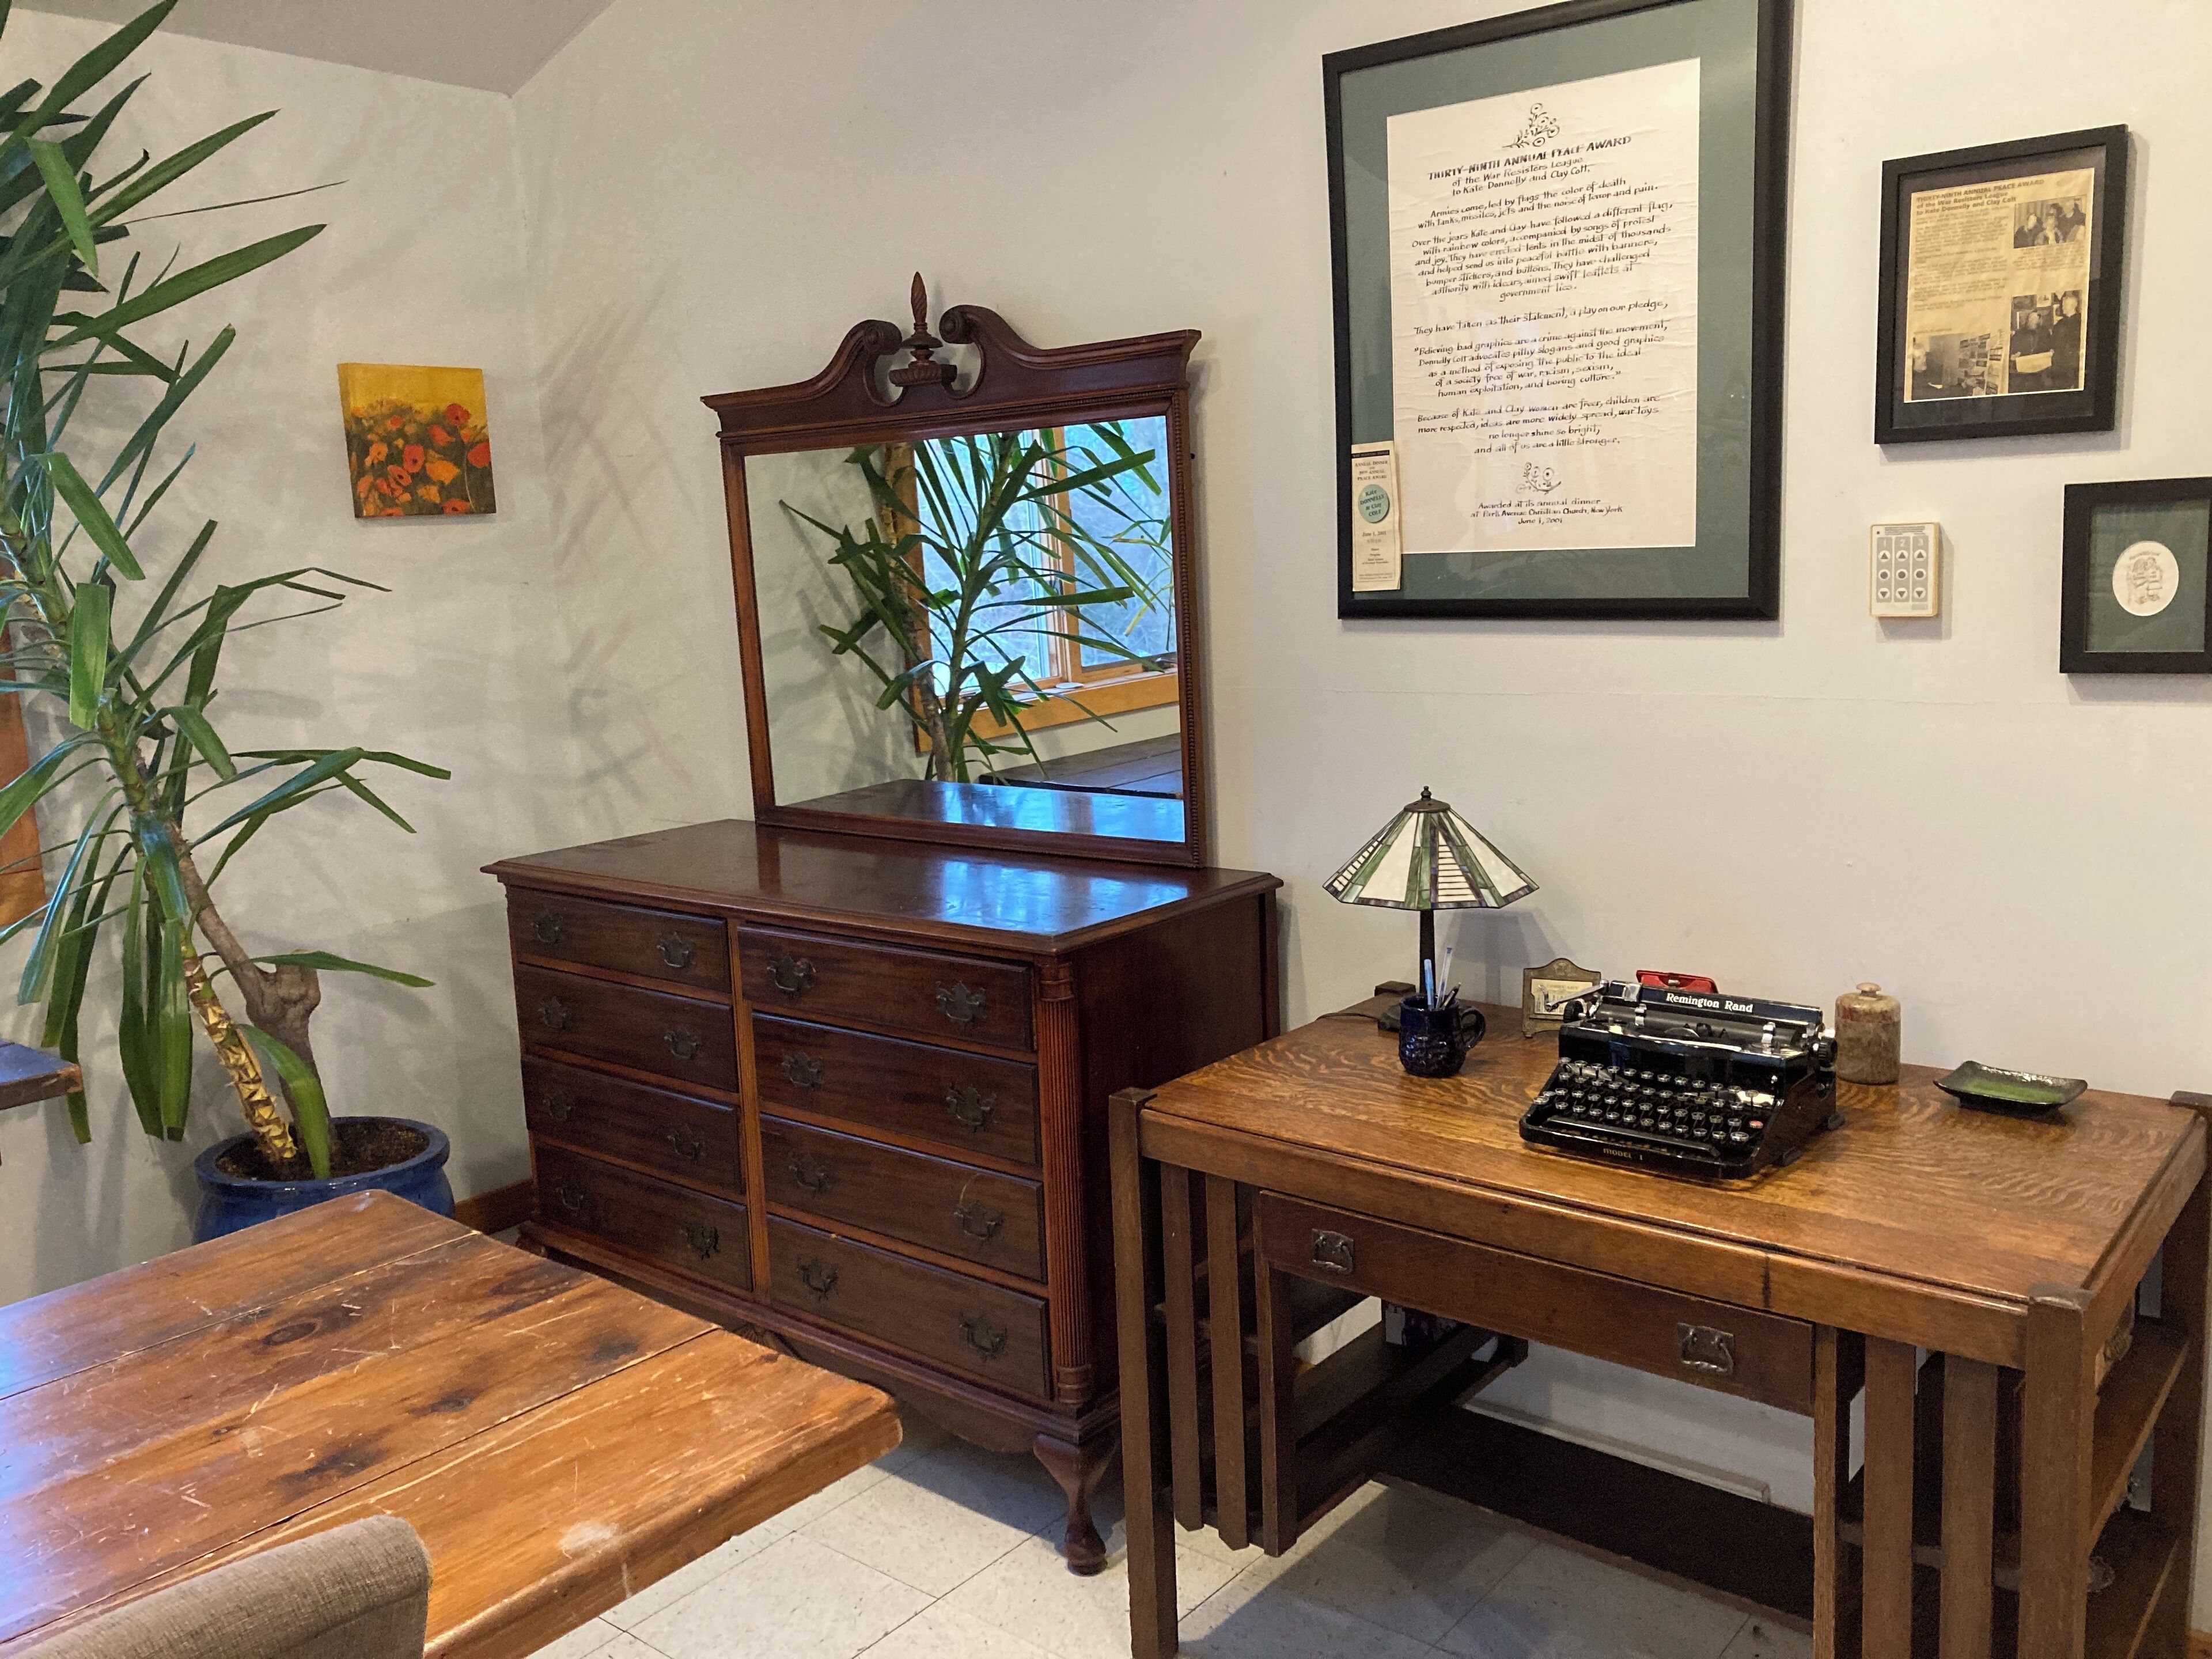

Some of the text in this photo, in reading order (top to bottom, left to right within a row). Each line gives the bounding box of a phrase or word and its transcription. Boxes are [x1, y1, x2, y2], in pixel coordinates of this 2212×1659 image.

[1503, 151, 1547, 166] ANNUAL
[1586, 136, 1631, 151] AWARD
[1465, 157, 1583, 184] the War Resisters League
[1463, 170, 1569, 194] Kate Donnelly and Clay
[1994, 183, 2015, 191] PEACE
[1418, 219, 1435, 229] with
[1497, 204, 1516, 218] jets
[1518, 202, 1535, 213] and
[1536, 201, 1552, 210] the
[1612, 185, 1631, 197] and
[1430, 177, 1626, 218] Armies led flags the color death
[1942, 204, 1969, 213] Donnelly
[1411, 240, 1431, 248] Over
[1432, 235, 1446, 244] the
[1471, 229, 1487, 238] Kate
[1489, 224, 1506, 235] and
[1509, 224, 1527, 233] Clay
[1530, 220, 1551, 229] have
[1554, 211, 1591, 226] followed
[1423, 224, 1609, 256] with rainbow colors, songs
[1414, 256, 1431, 266] and
[1448, 253, 1466, 264] They
[1562, 237, 1575, 247] the
[1578, 233, 1605, 244] midst
[1618, 224, 1671, 238] thousands
[1418, 243, 1609, 276] and send with
[1426, 277, 1457, 287] bumper
[1494, 267, 1513, 277] and
[1516, 264, 1551, 275] buttons.
[1551, 260, 1573, 271] They
[1575, 259, 1595, 267] have
[1472, 281, 1490, 290] with
[1499, 285, 1554, 302] government
[1413, 326, 1433, 336] They
[1435, 324, 1454, 332] have
[1456, 320, 1482, 329] taken
[1498, 315, 1521, 325] their
[1456, 341, 1473, 351] bad
[1538, 332, 1562, 342] crime
[1598, 327, 1613, 335] the
[1418, 357, 1452, 367] Donnelly
[1537, 344, 1573, 355] slogans
[1575, 339, 1593, 349] and
[1596, 336, 1620, 350] good
[1537, 357, 1553, 366] the
[1556, 354, 1584, 366] public
[1598, 350, 1614, 359] the
[1438, 376, 1576, 397] human exploitation, and boring
[1484, 373, 1503, 384] free
[1462, 408, 1481, 417] Kate
[1484, 405, 1502, 415] and
[1505, 404, 1525, 416] Clay
[1605, 395, 1640, 405] children
[1548, 412, 1577, 424] widely
[1581, 407, 1617, 421] spread,
[1501, 429, 1530, 441] longer
[1531, 429, 1554, 437] shine
[1474, 444, 1492, 454] and
[1495, 444, 1506, 452] all
[1478, 500, 1512, 509] Awarded
[1603, 505, 1623, 516] York
[1666, 993, 1753, 1013] Remington Rand
